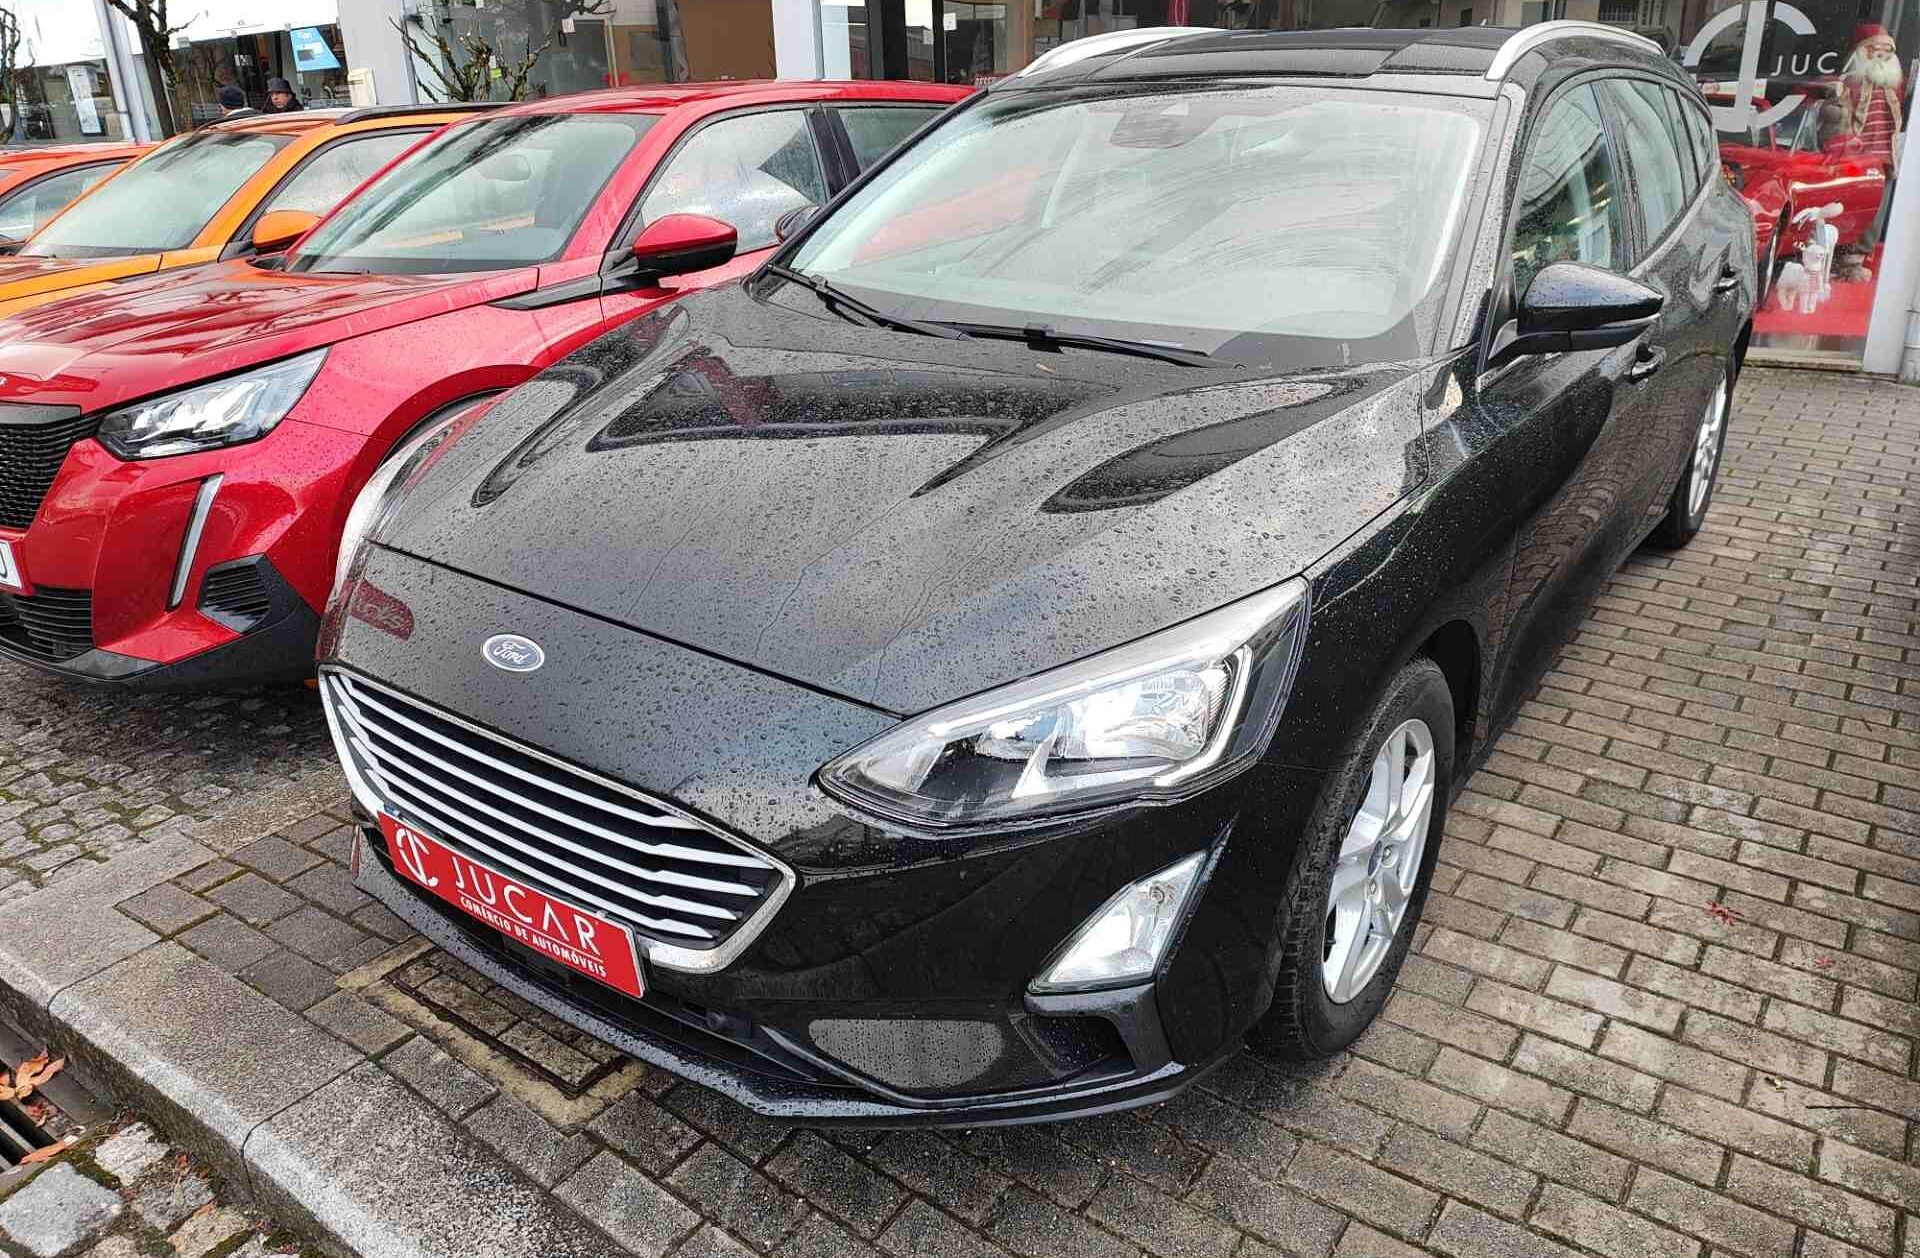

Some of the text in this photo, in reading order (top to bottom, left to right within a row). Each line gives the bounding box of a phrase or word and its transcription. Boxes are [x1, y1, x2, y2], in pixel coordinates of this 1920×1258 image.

[493, 640, 531, 664] Ford
[454, 856, 601, 954] JUCAR
[460, 896, 607, 978] COMÉRCIO DE AUTOMÓVEIS
